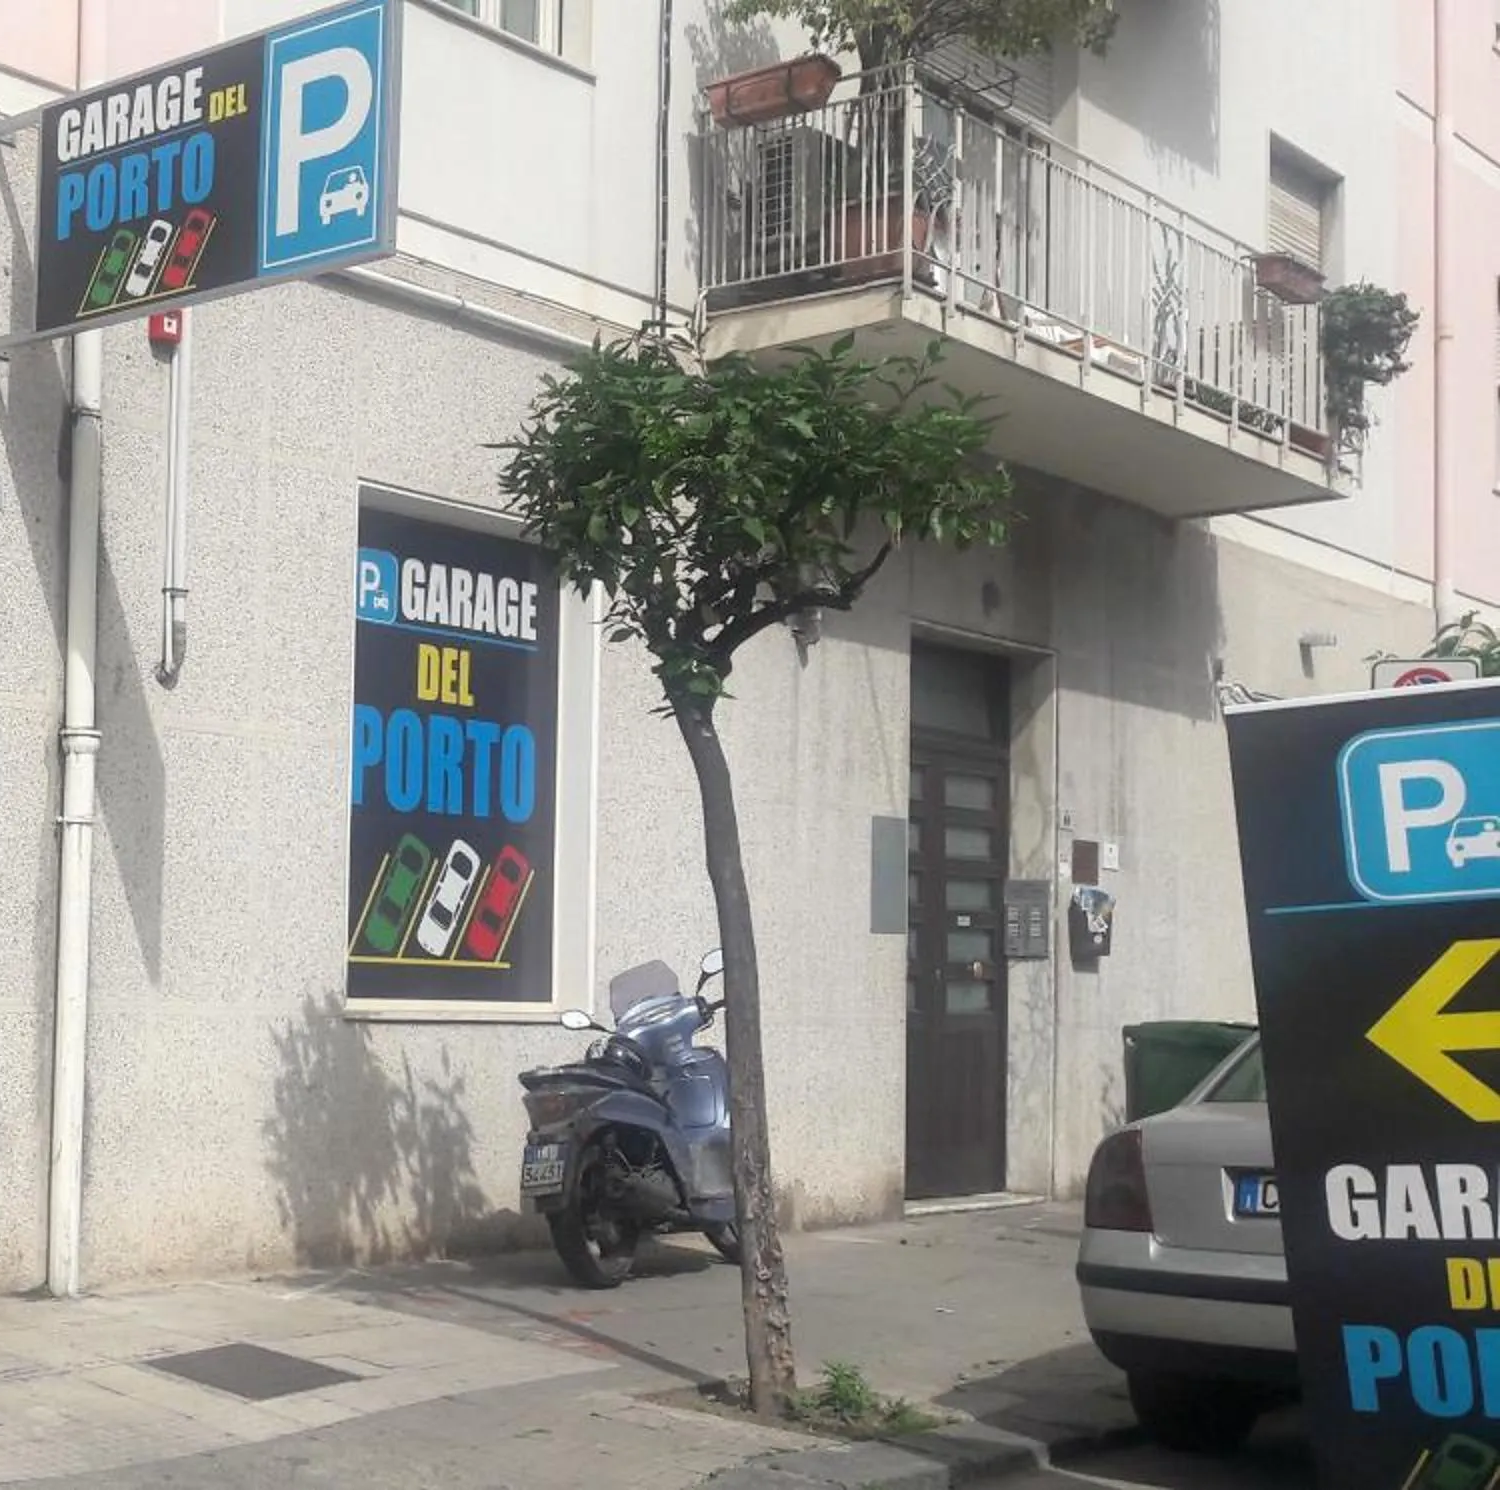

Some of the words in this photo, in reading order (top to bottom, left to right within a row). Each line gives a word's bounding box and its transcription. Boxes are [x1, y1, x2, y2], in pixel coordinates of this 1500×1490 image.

[57, 67, 204, 163] GARAGE
[209, 83, 248, 125] DEL
[276, 46, 373, 237] P
[56, 131, 216, 241] PORTO
[359, 560, 381, 609] P
[401, 557, 539, 642] GARAGE
[416, 643, 475, 708] DEL
[352, 703, 537, 824] PORTO
[1378, 759, 1467, 873] P
[1325, 1163, 1500, 1241] GAR
